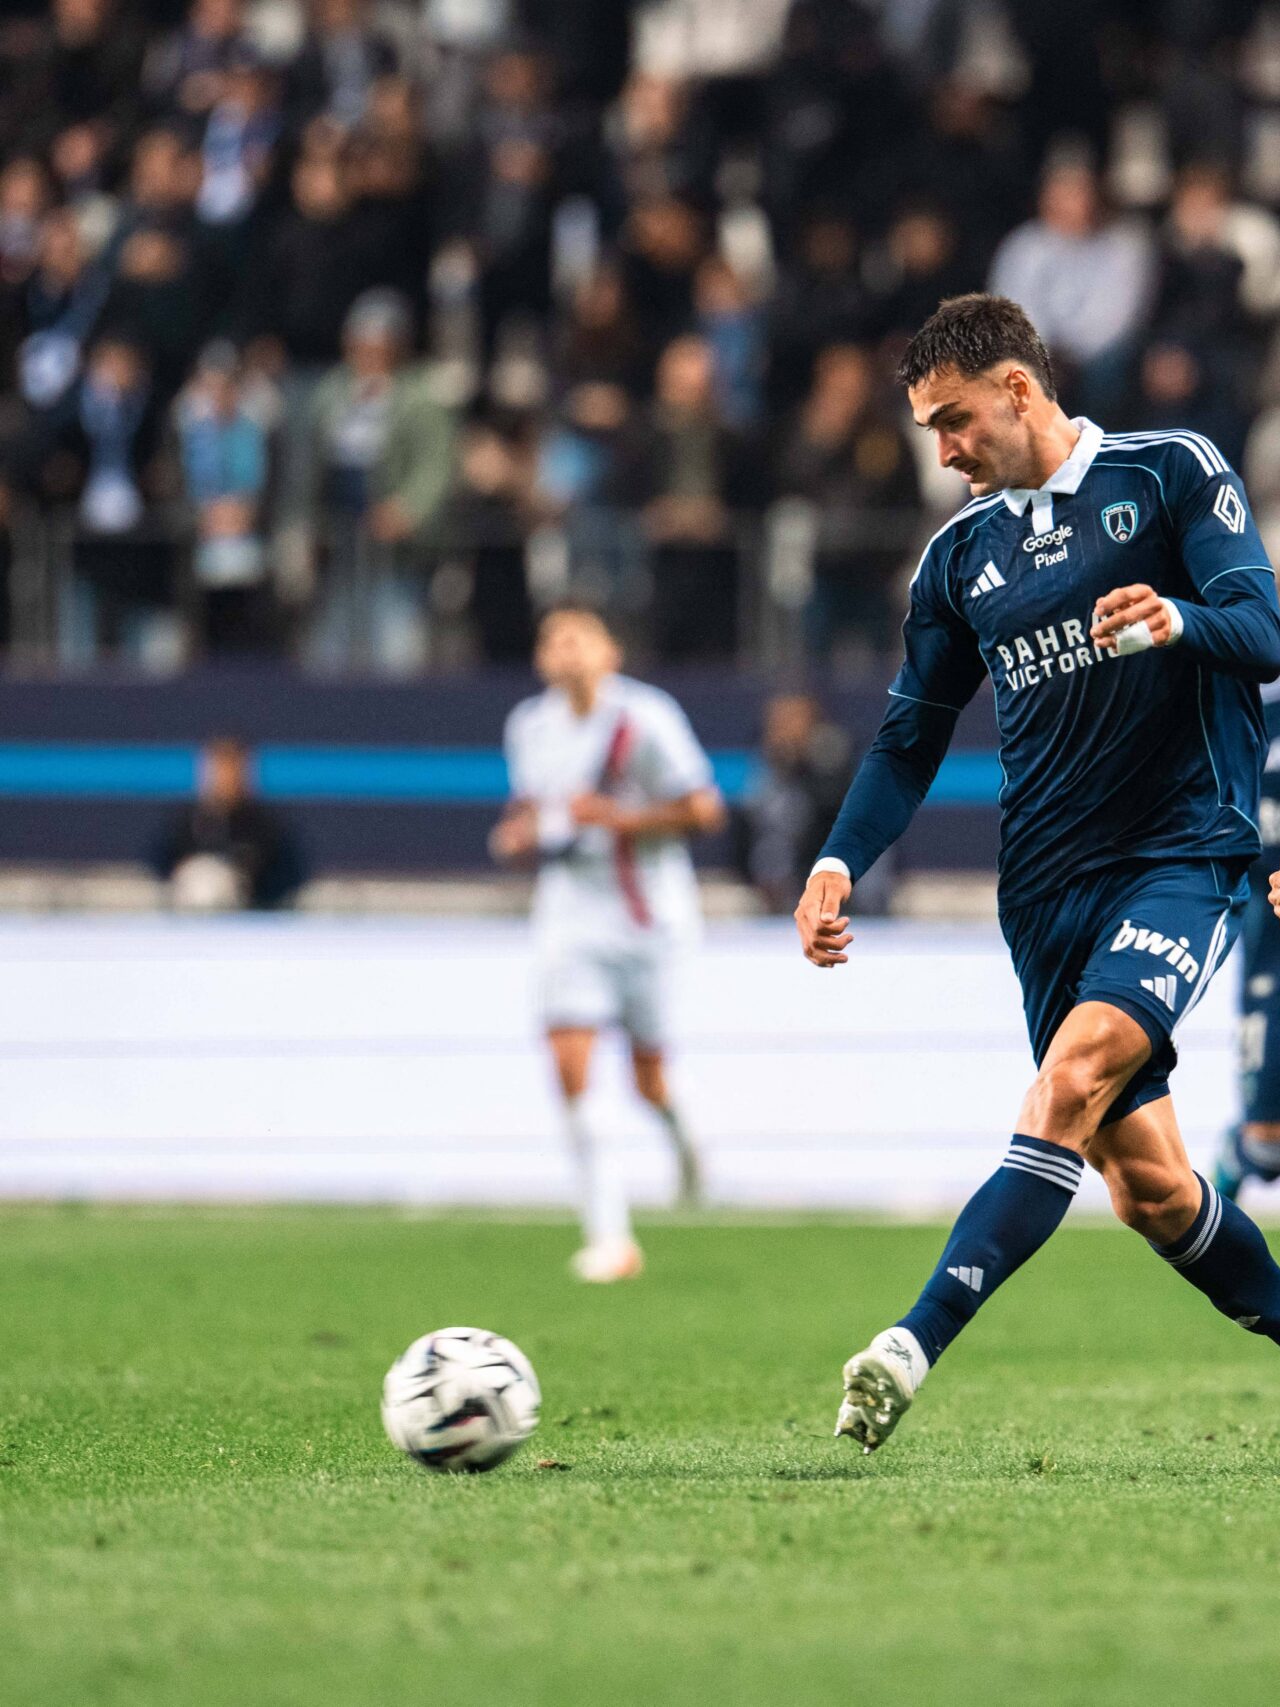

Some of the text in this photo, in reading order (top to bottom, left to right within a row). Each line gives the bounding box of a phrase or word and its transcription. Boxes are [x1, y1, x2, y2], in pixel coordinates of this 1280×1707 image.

[1022, 524, 1074, 553] Google
[1034, 544, 1068, 570] Pixel
[1110, 919, 1200, 984] bwin
